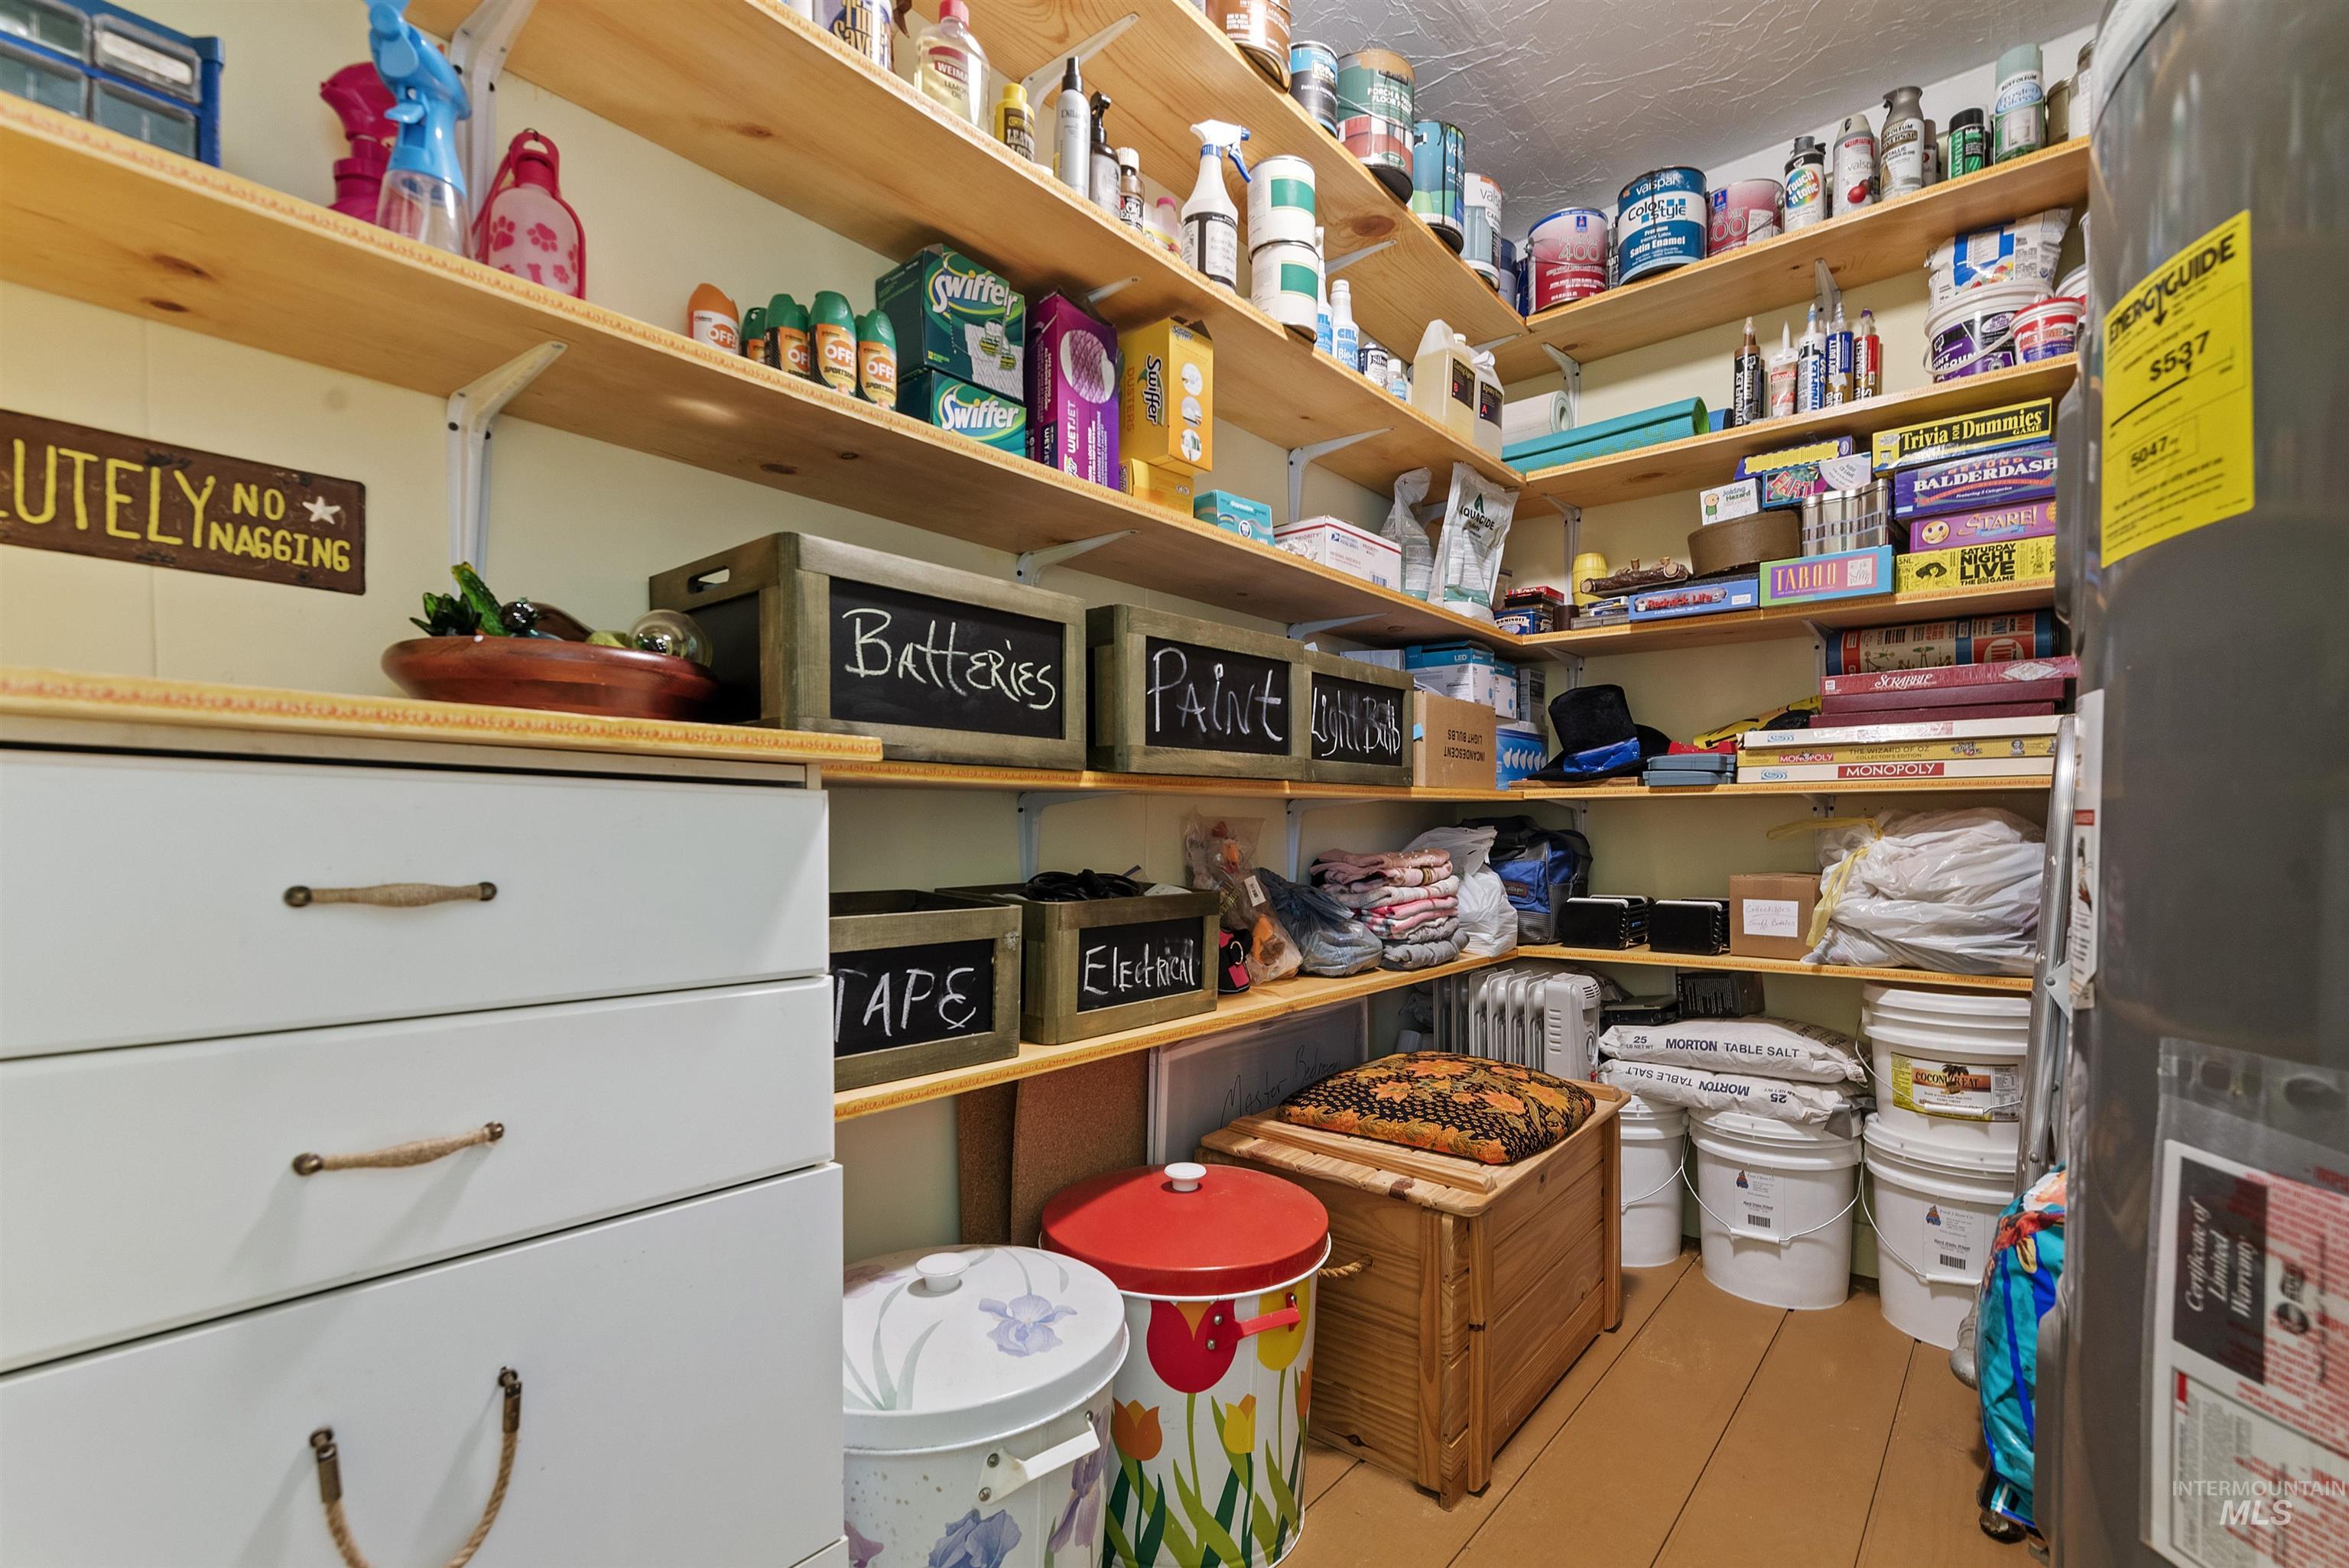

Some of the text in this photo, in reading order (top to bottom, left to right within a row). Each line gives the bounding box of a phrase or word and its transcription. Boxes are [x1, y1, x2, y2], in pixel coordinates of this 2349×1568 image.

[951, 89, 963, 100] OIL
[1367, 87, 1392, 99] PORCH
[1372, 95, 1396, 107] FLOOR
[1786, 169, 1815, 196] Touch
[1798, 181, 1819, 203] tone
[1126, 200, 1140, 216] Old
[1628, 200, 1665, 222] Color
[1558, 243, 1600, 262] 400
[1629, 243, 1651, 258] Satin
[1652, 235, 1686, 249] Enamel
[932, 273, 1019, 317] Swiffer
[2107, 232, 2237, 346] ENERGYGUIDE
[707, 326, 739, 348] OFF!
[787, 347, 810, 365] OF
[824, 341, 856, 368] OFF!
[1854, 341, 1863, 381] PROJECTS
[1934, 353, 1951, 368] OINT
[2149, 329, 2211, 382] $537
[865, 361, 895, 383] OFF!
[1143, 353, 1163, 427] Swiffer
[1454, 381, 1459, 392] B
[1126, 367, 1135, 432] DUSTERS
[1481, 403, 1488, 414] A
[1735, 372, 1745, 426] DYNAFLEX
[942, 394, 1019, 430] Swiffer
[1067, 400, 1077, 454] WETJET
[1901, 407, 2043, 452] Trivia FOR Dummies
[2012, 424, 2042, 436] GAME
[1771, 470, 1815, 499] FART!
[1912, 456, 2058, 493] BALDERDASH
[0, 438, 286, 549] UTELY NO
[1722, 485, 1746, 497] Joking
[1725, 490, 1751, 502] Hazard
[1955, 485, 2013, 499] Featuring Categories
[1458, 505, 1496, 531] AQUACIDE
[1959, 505, 2038, 535] STARE!
[208, 521, 352, 573] NAGGING
[1961, 542, 2016, 555] SATURDAY
[1961, 549, 2016, 566] NIGHT
[1775, 562, 1837, 592] TABOO
[1961, 560, 2016, 581] LIVE
[1990, 574, 2016, 583] GAME
[1647, 592, 1714, 610] Redneck Life
[1874, 673, 1935, 690] SCRABBLE
[1447, 729, 1483, 745] LIGHT BULBS
[1444, 746, 1486, 762] INCANDESCENT
[1779, 752, 1834, 764] MONOPOLY
[1845, 763, 1936, 778] MONOPOLY
[832, 966, 977, 1044] TAPE
[1665, 1038, 1800, 1058] MORTON TABLE SALT
[1625, 1066, 1750, 1097] MORTON TABLE SALT
[1915, 1070, 1951, 1083] COCONU
[1955, 1076, 1980, 1088] REAT
[1219, 1071, 1290, 1130] Master
[1769, 1092, 1788, 1104] 25
[2184, 1196, 2212, 1313] Certificate of
[2207, 1228, 2230, 1303] Limited
[2230, 1234, 2258, 1320] Warranty
